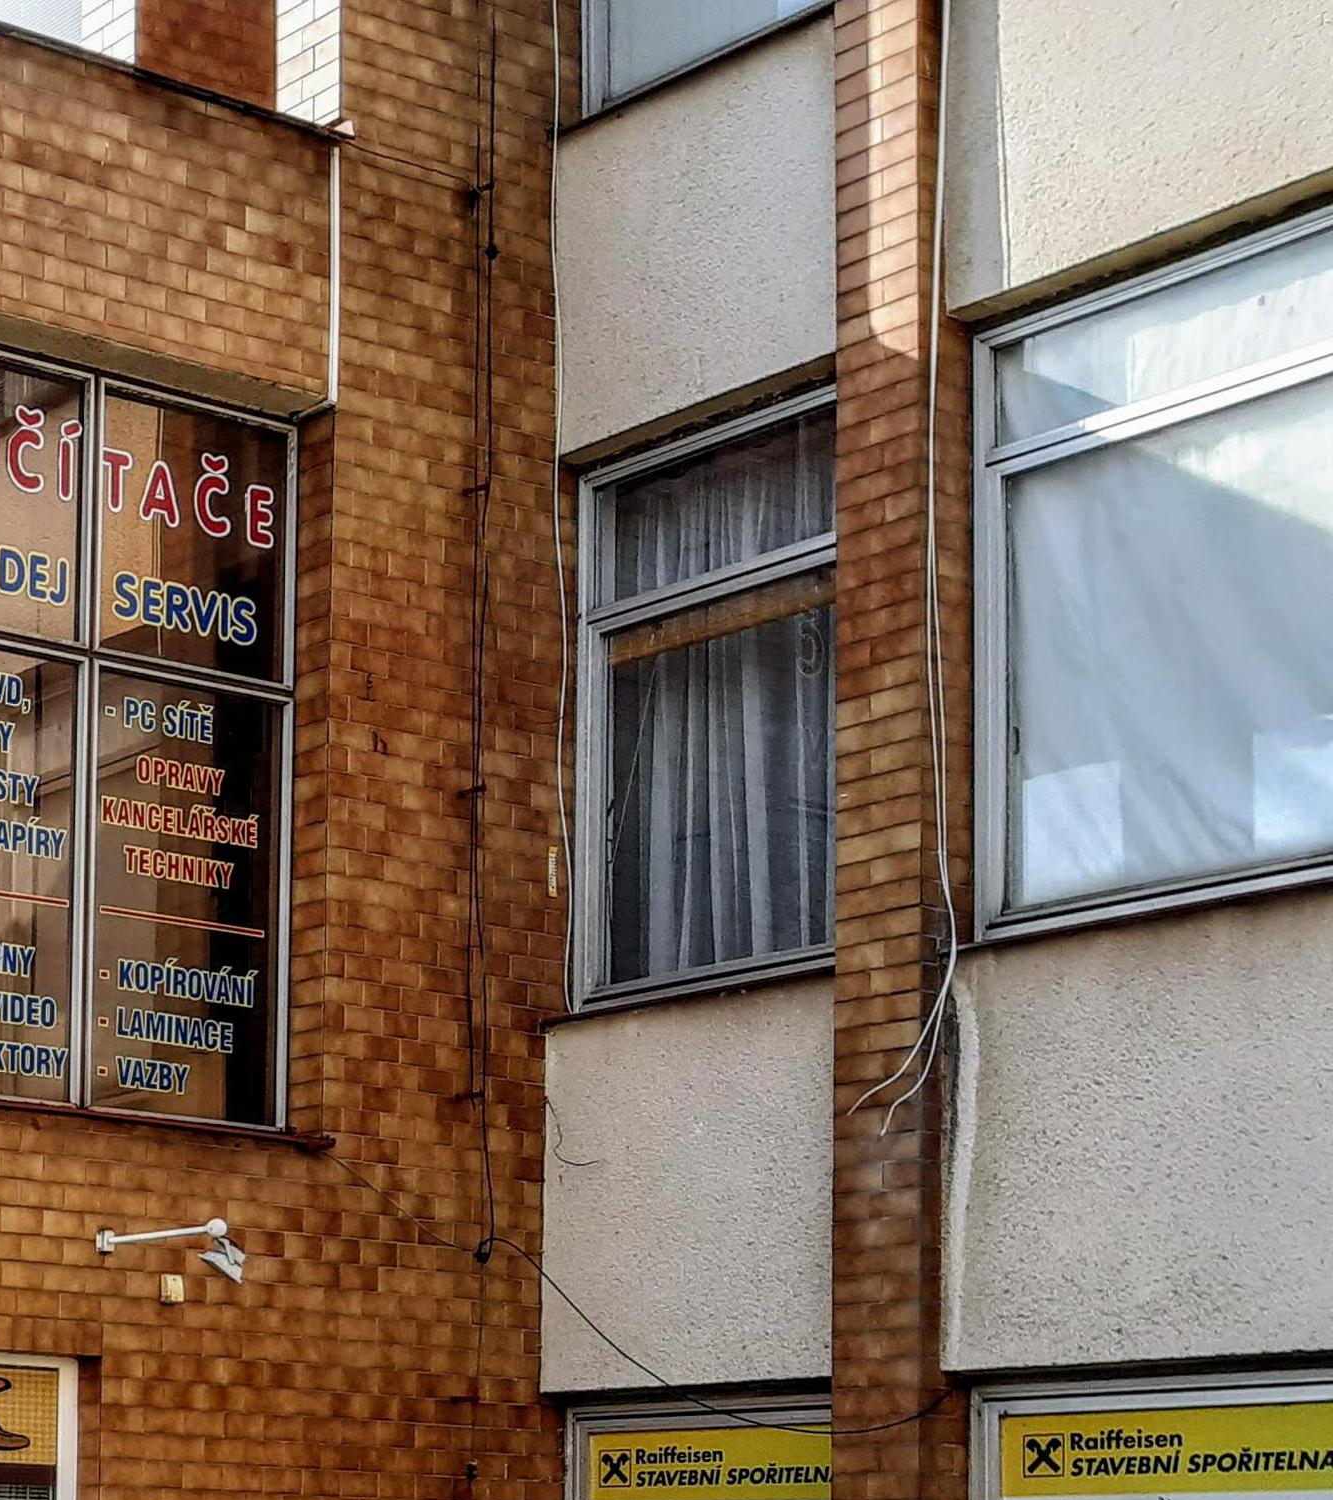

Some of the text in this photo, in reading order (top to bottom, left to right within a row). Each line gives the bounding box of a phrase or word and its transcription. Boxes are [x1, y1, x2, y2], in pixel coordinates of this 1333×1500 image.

[113, 571, 257, 646] SERVIS
[123, 698, 214, 745] PC SÍTĚ
[135, 755, 225, 797] OPRAVY
[101, 797, 259, 849] KANCELÁŘSKÉ
[124, 846, 234, 890] TECHNIKY
[117, 957, 259, 1008] KOPÍROVÁNÍ
[116, 1006, 234, 1054] LAMINACE
[116, 1055, 190, 1095] VAZBY
[635, 1446, 724, 1465] Raiffeisen
[1070, 1429, 1183, 1452] Raiffeisen
[1070, 1446, 1333, 1477] STAVEBNÍ SPOŘITELNA
[636, 1463, 832, 1488] STAVEBNÍ SPOŘITELN
